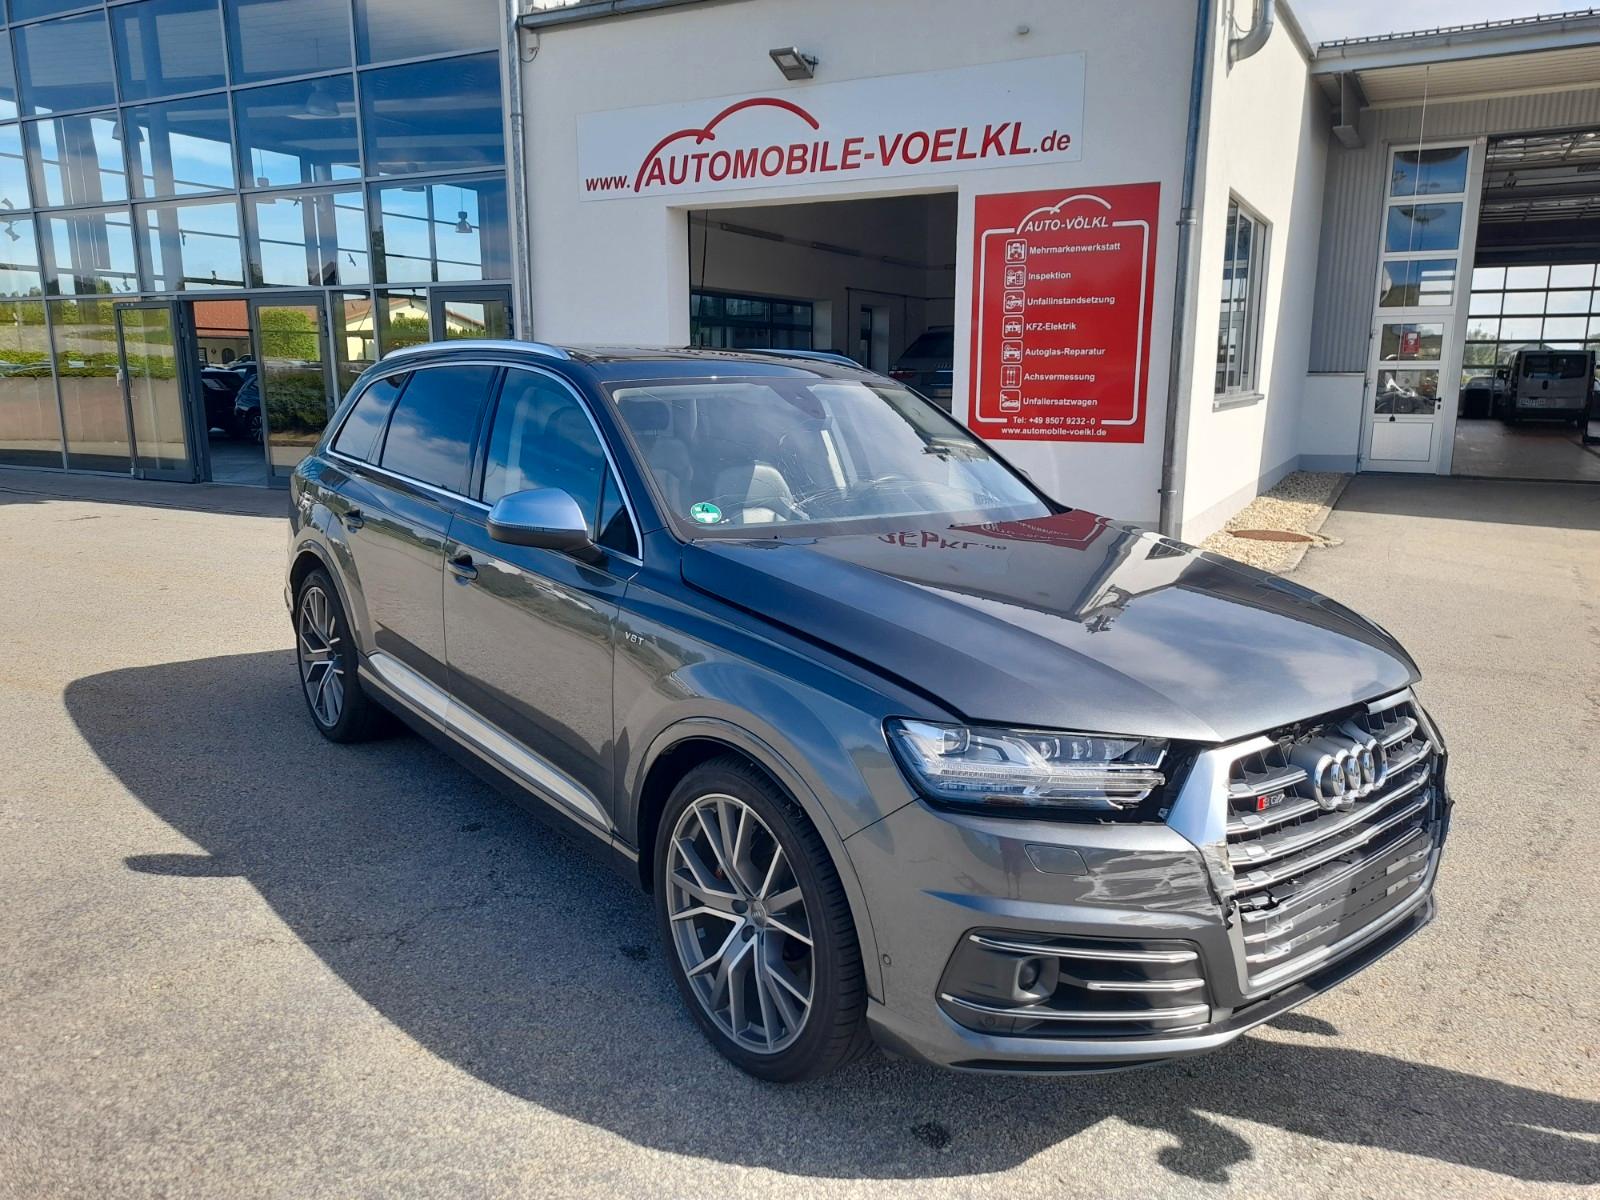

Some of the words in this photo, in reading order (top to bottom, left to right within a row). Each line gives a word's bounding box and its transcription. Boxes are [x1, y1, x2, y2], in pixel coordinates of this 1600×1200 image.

[1025, 216, 1109, 232] AUTO-VÖLKL
[1029, 242, 1120, 254] Mehrmarkenwerkstatt
[1028, 270, 1071, 281] Inspektion
[1027, 295, 1115, 306] Unfallinstandsetzung
[1025, 321, 1077, 331] KFZ-Elektrik
[1025, 347, 1106, 358] Autoglas-Reparatur
[1023, 372, 1095, 382] Achsvermessung
[1022, 397, 1098, 407] Unfallersatzwagen
[1028, 416, 1043, 424] +49
[1045, 416, 1064, 425] 8507
[1001, 427, 1107, 436] www.automobile-voelkl.de
[625, 631, 645, 646] V8T
